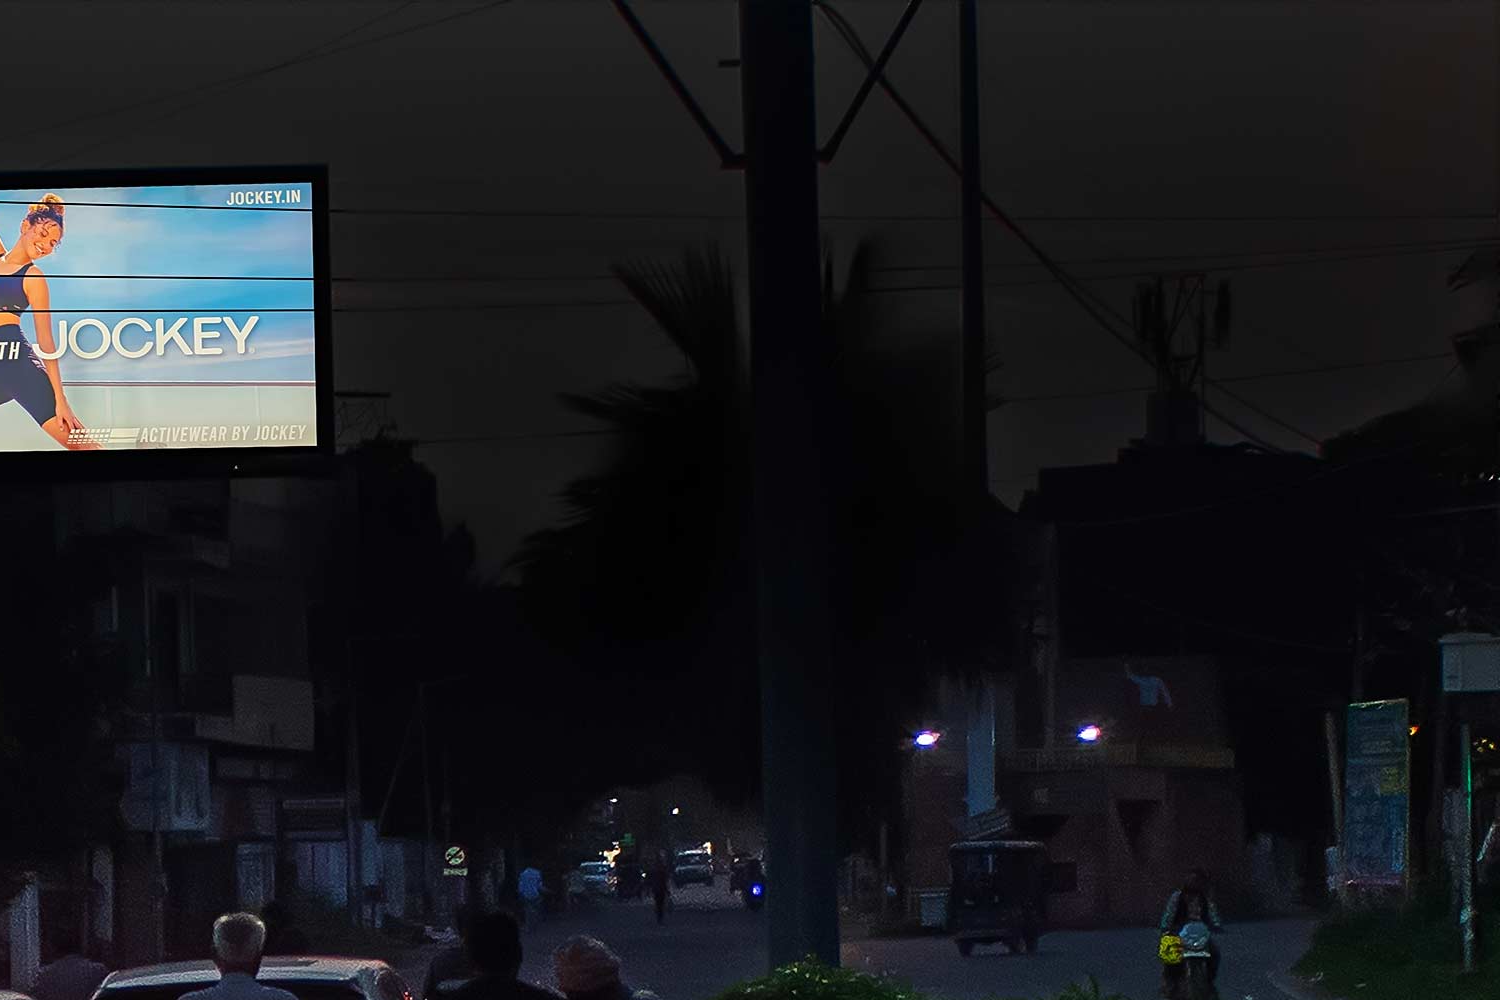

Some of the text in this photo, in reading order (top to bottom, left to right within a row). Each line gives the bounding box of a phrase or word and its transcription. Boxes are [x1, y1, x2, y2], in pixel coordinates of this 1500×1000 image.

[226, 189, 301, 206] JOCKEY.IN
[32, 316, 259, 360] JOCKEY
[140, 424, 308, 443] ACTIVEWEAR BY JOCKEY
